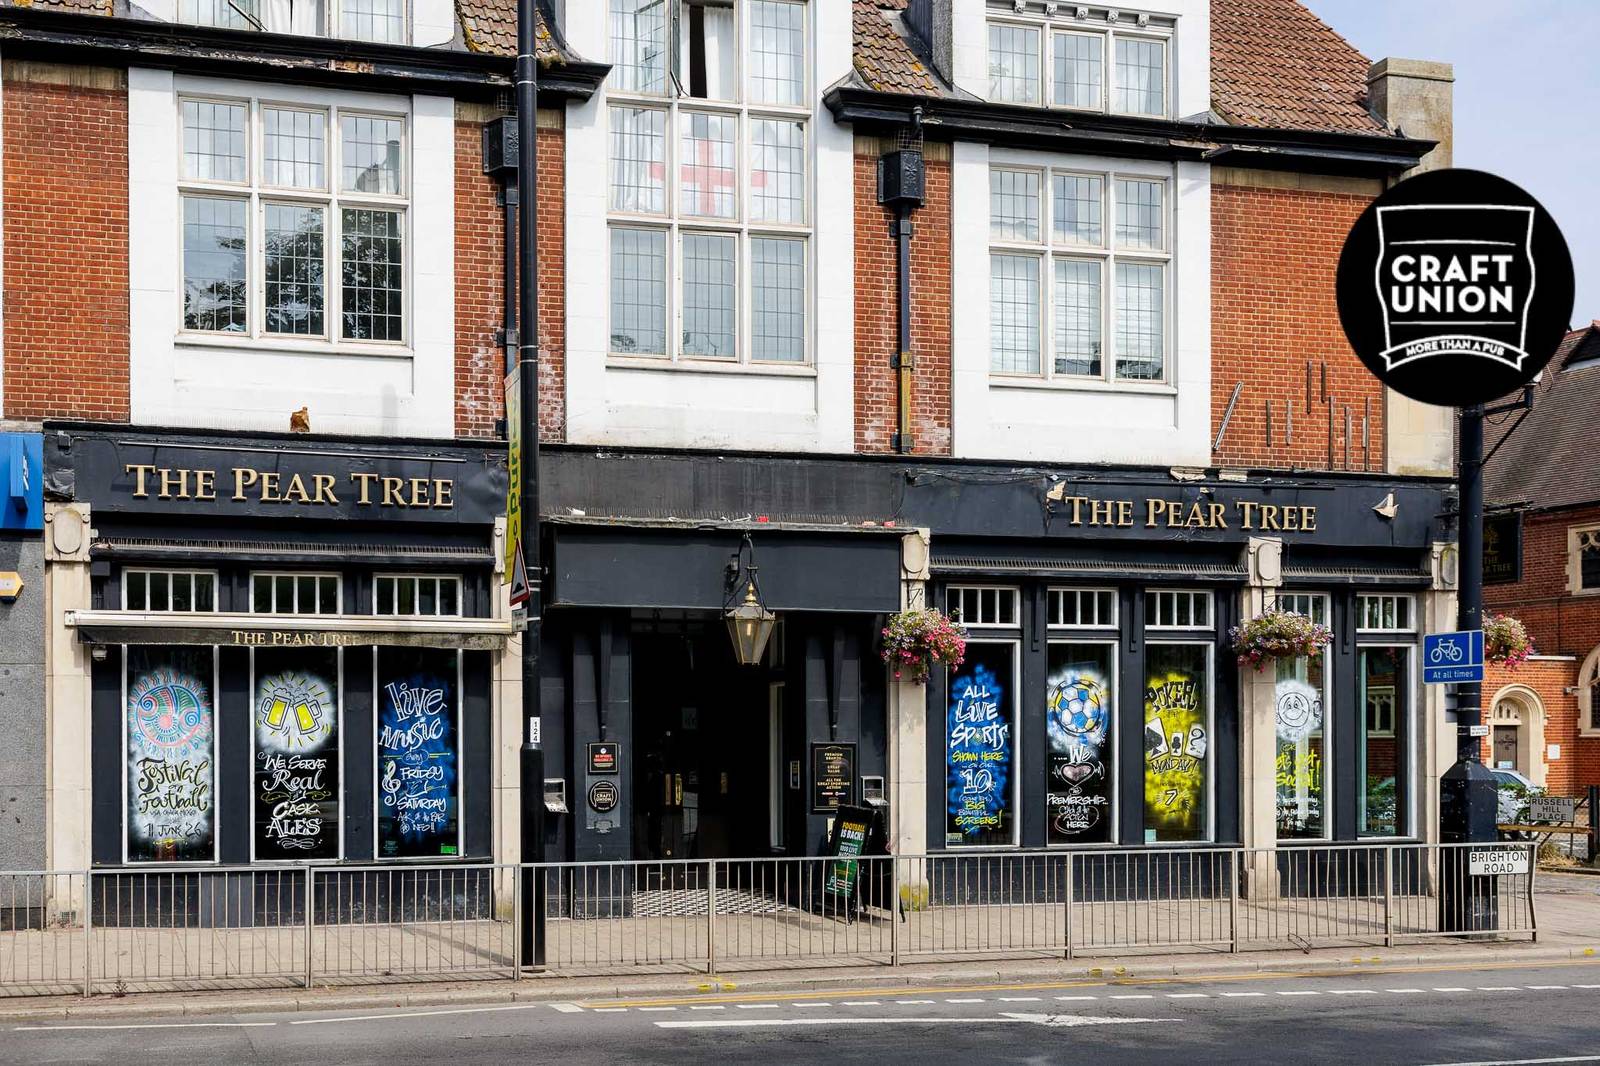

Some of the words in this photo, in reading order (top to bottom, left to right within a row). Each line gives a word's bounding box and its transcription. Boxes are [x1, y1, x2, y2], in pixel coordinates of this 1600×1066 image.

[126, 464, 217, 499] THE
[231, 467, 341, 504] PEAR
[350, 472, 455, 507] TREE
[1065, 496, 1134, 527] THE
[1144, 497, 1229, 529] PEAR
[1236, 501, 1317, 533] TREE
[231, 630, 267, 645] THE
[270, 631, 316, 646] PEAR
[1432, 671, 1441, 679] At
[1442, 670, 1452, 679] all
[1454, 670, 1474, 679] times
[963, 685, 991, 699] ALL
[1145, 680, 1198, 713] POKER
[952, 750, 979, 763] SHOWN
[981, 750, 1004, 762] HERE
[1069, 745, 1092, 764] We
[262, 769, 325, 792] Real
[400, 766, 444, 782] FRIDAY
[961, 768, 993, 794] 10
[138, 784, 208, 813] Football
[397, 798, 447, 812] SATURDAY
[1165, 789, 1179, 806] 7
[1531, 799, 1573, 807] RUSSELL
[1536, 812, 1567, 821] PLACE
[157, 824, 183, 838] JUNE
[265, 816, 323, 839] ALES
[842, 821, 865, 833] FOOTBALL
[1471, 851, 1528, 863] BRIGHTON
[1483, 863, 1514, 874] ROAD
